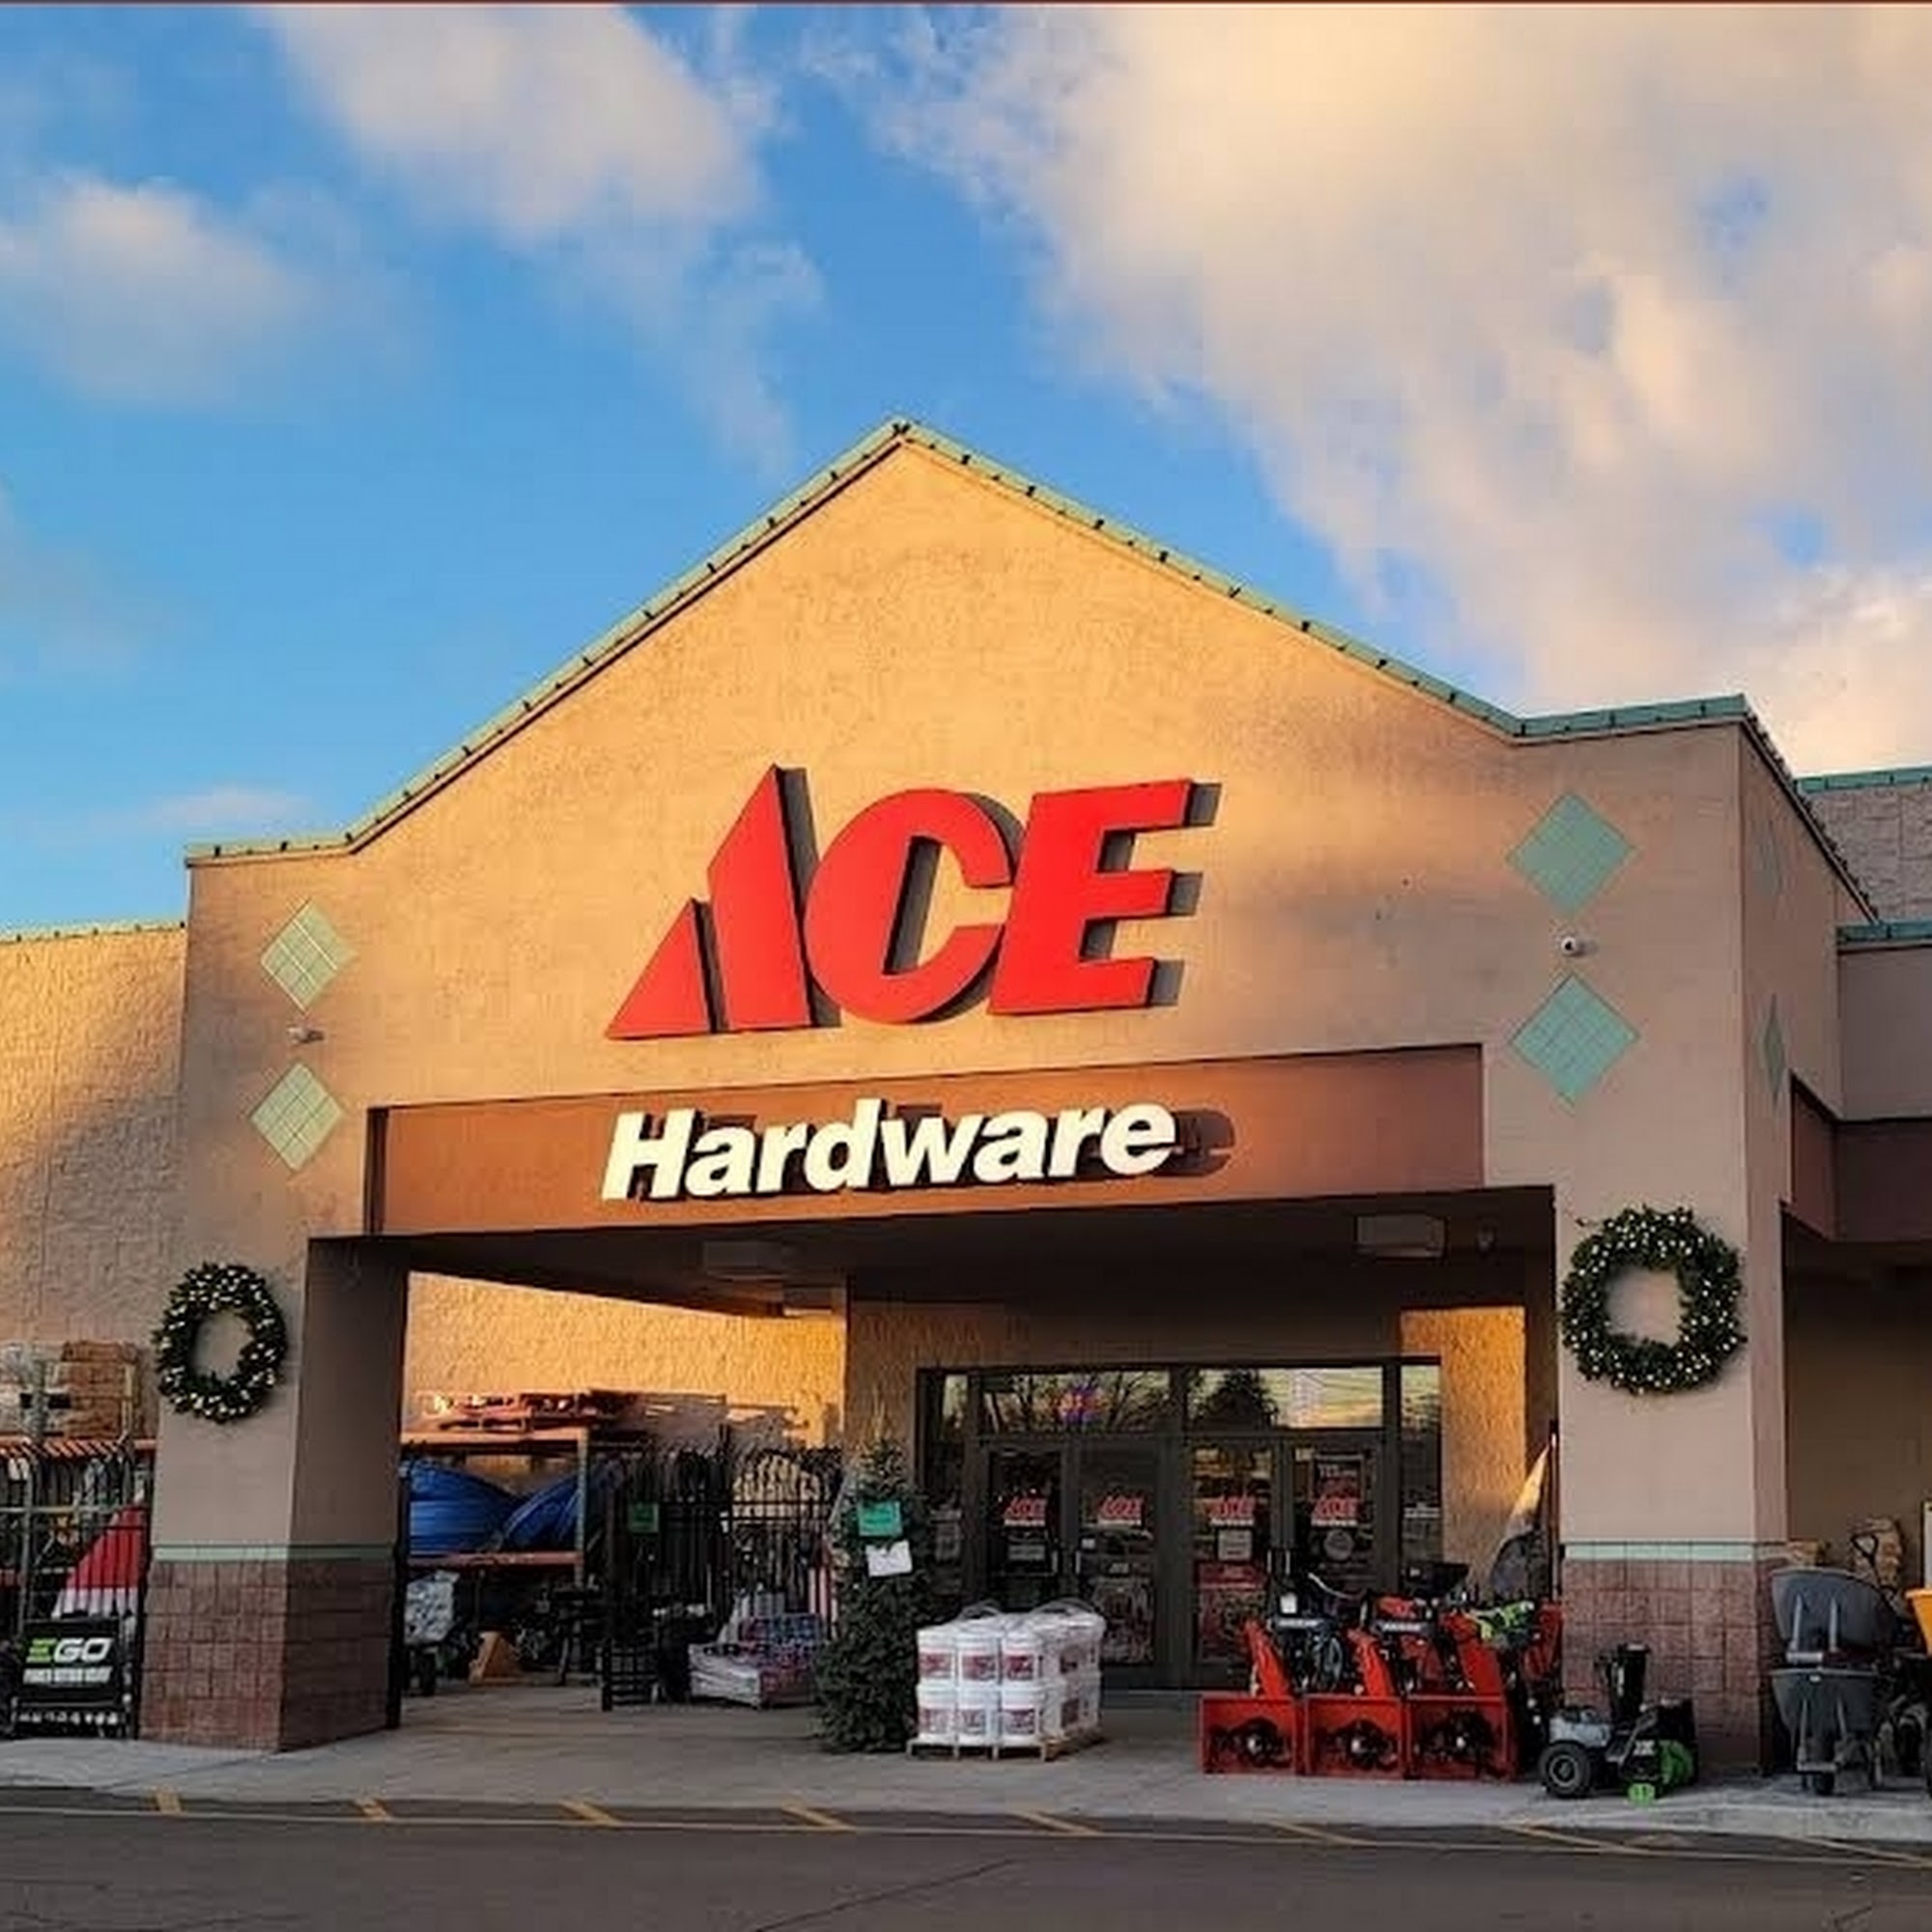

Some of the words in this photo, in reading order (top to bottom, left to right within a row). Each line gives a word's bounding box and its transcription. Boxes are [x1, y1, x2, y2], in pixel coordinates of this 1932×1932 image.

[605, 762, 1196, 1040] ACE
[601, 1097, 1178, 1202] Hardware
[25, 1636, 115, 1663] EGO
